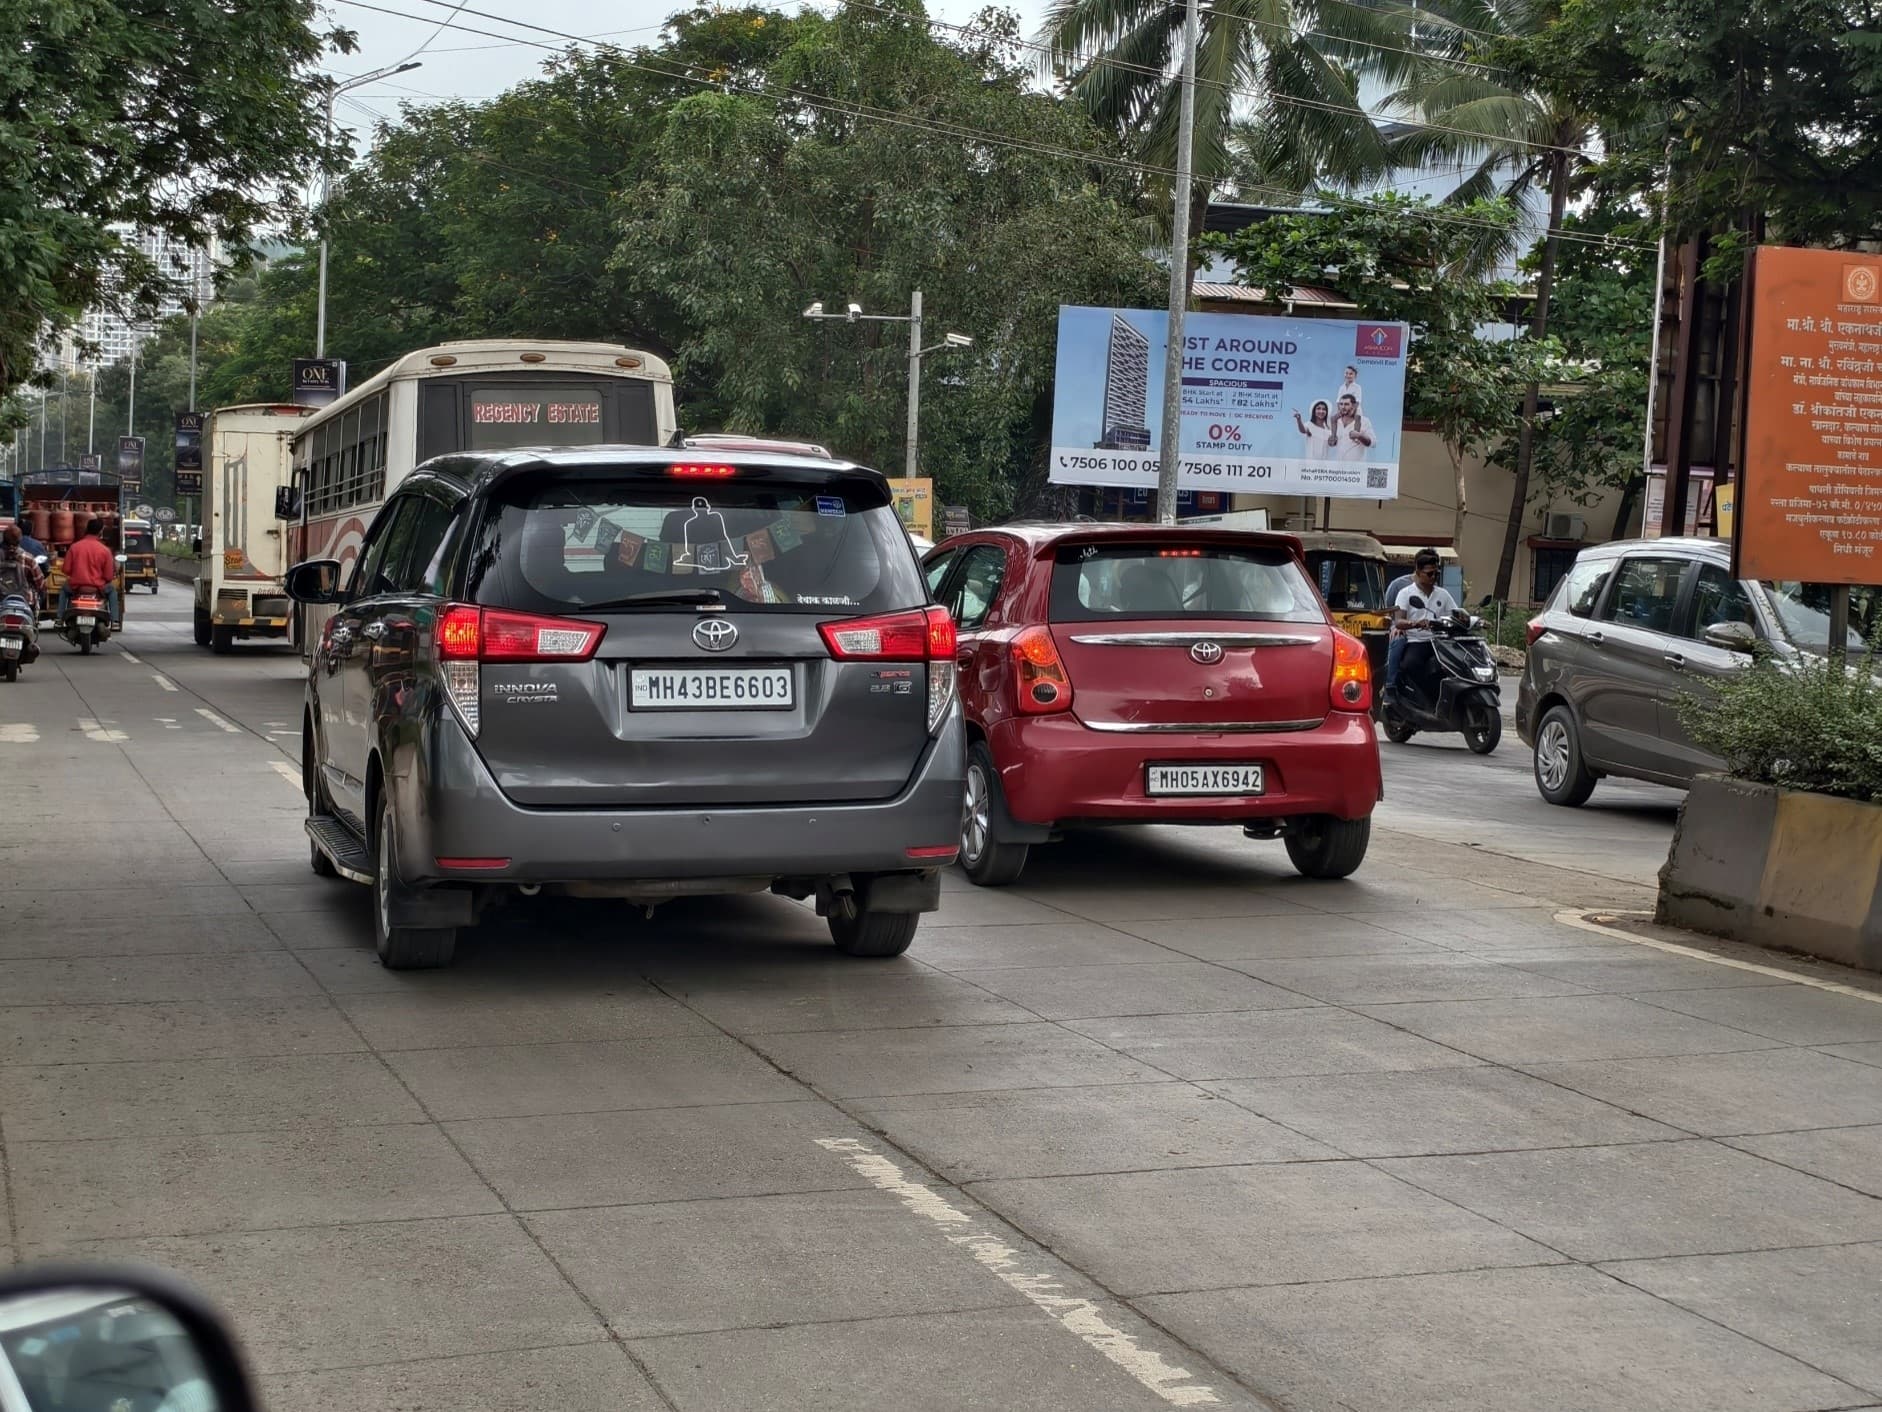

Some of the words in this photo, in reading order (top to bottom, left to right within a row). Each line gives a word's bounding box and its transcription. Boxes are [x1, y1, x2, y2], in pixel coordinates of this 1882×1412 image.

[1214, 338, 1297, 354] AROUND
[1181, 356, 1206, 371] HE
[1211, 358, 1290, 374] CORNER
[1781, 356, 1796, 368] मा.
[1800, 357, 1814, 368] ना.
[1819, 356, 1833, 370] श्री.
[1208, 379, 1248, 389] SPACIOUS
[473, 402, 540, 423] REGENCY
[547, 402, 600, 423] ESTATE
[1208, 424, 1242, 441] 0%
[1196, 441, 1226, 450] STAMP
[1228, 443, 1253, 451] DUTY
[1070, 456, 1107, 470] 7506
[1112, 458, 1138, 472] 100
[1185, 462, 1222, 476] 7506
[1226, 464, 1243, 477] 111
[1247, 465, 1272, 478] 201
[494, 683, 558, 694] INNOVA
[648, 676, 788, 699] MH43BE6603
[507, 695, 558, 704] CRYSTA
[1160, 770, 1260, 789] MH05AX6942
